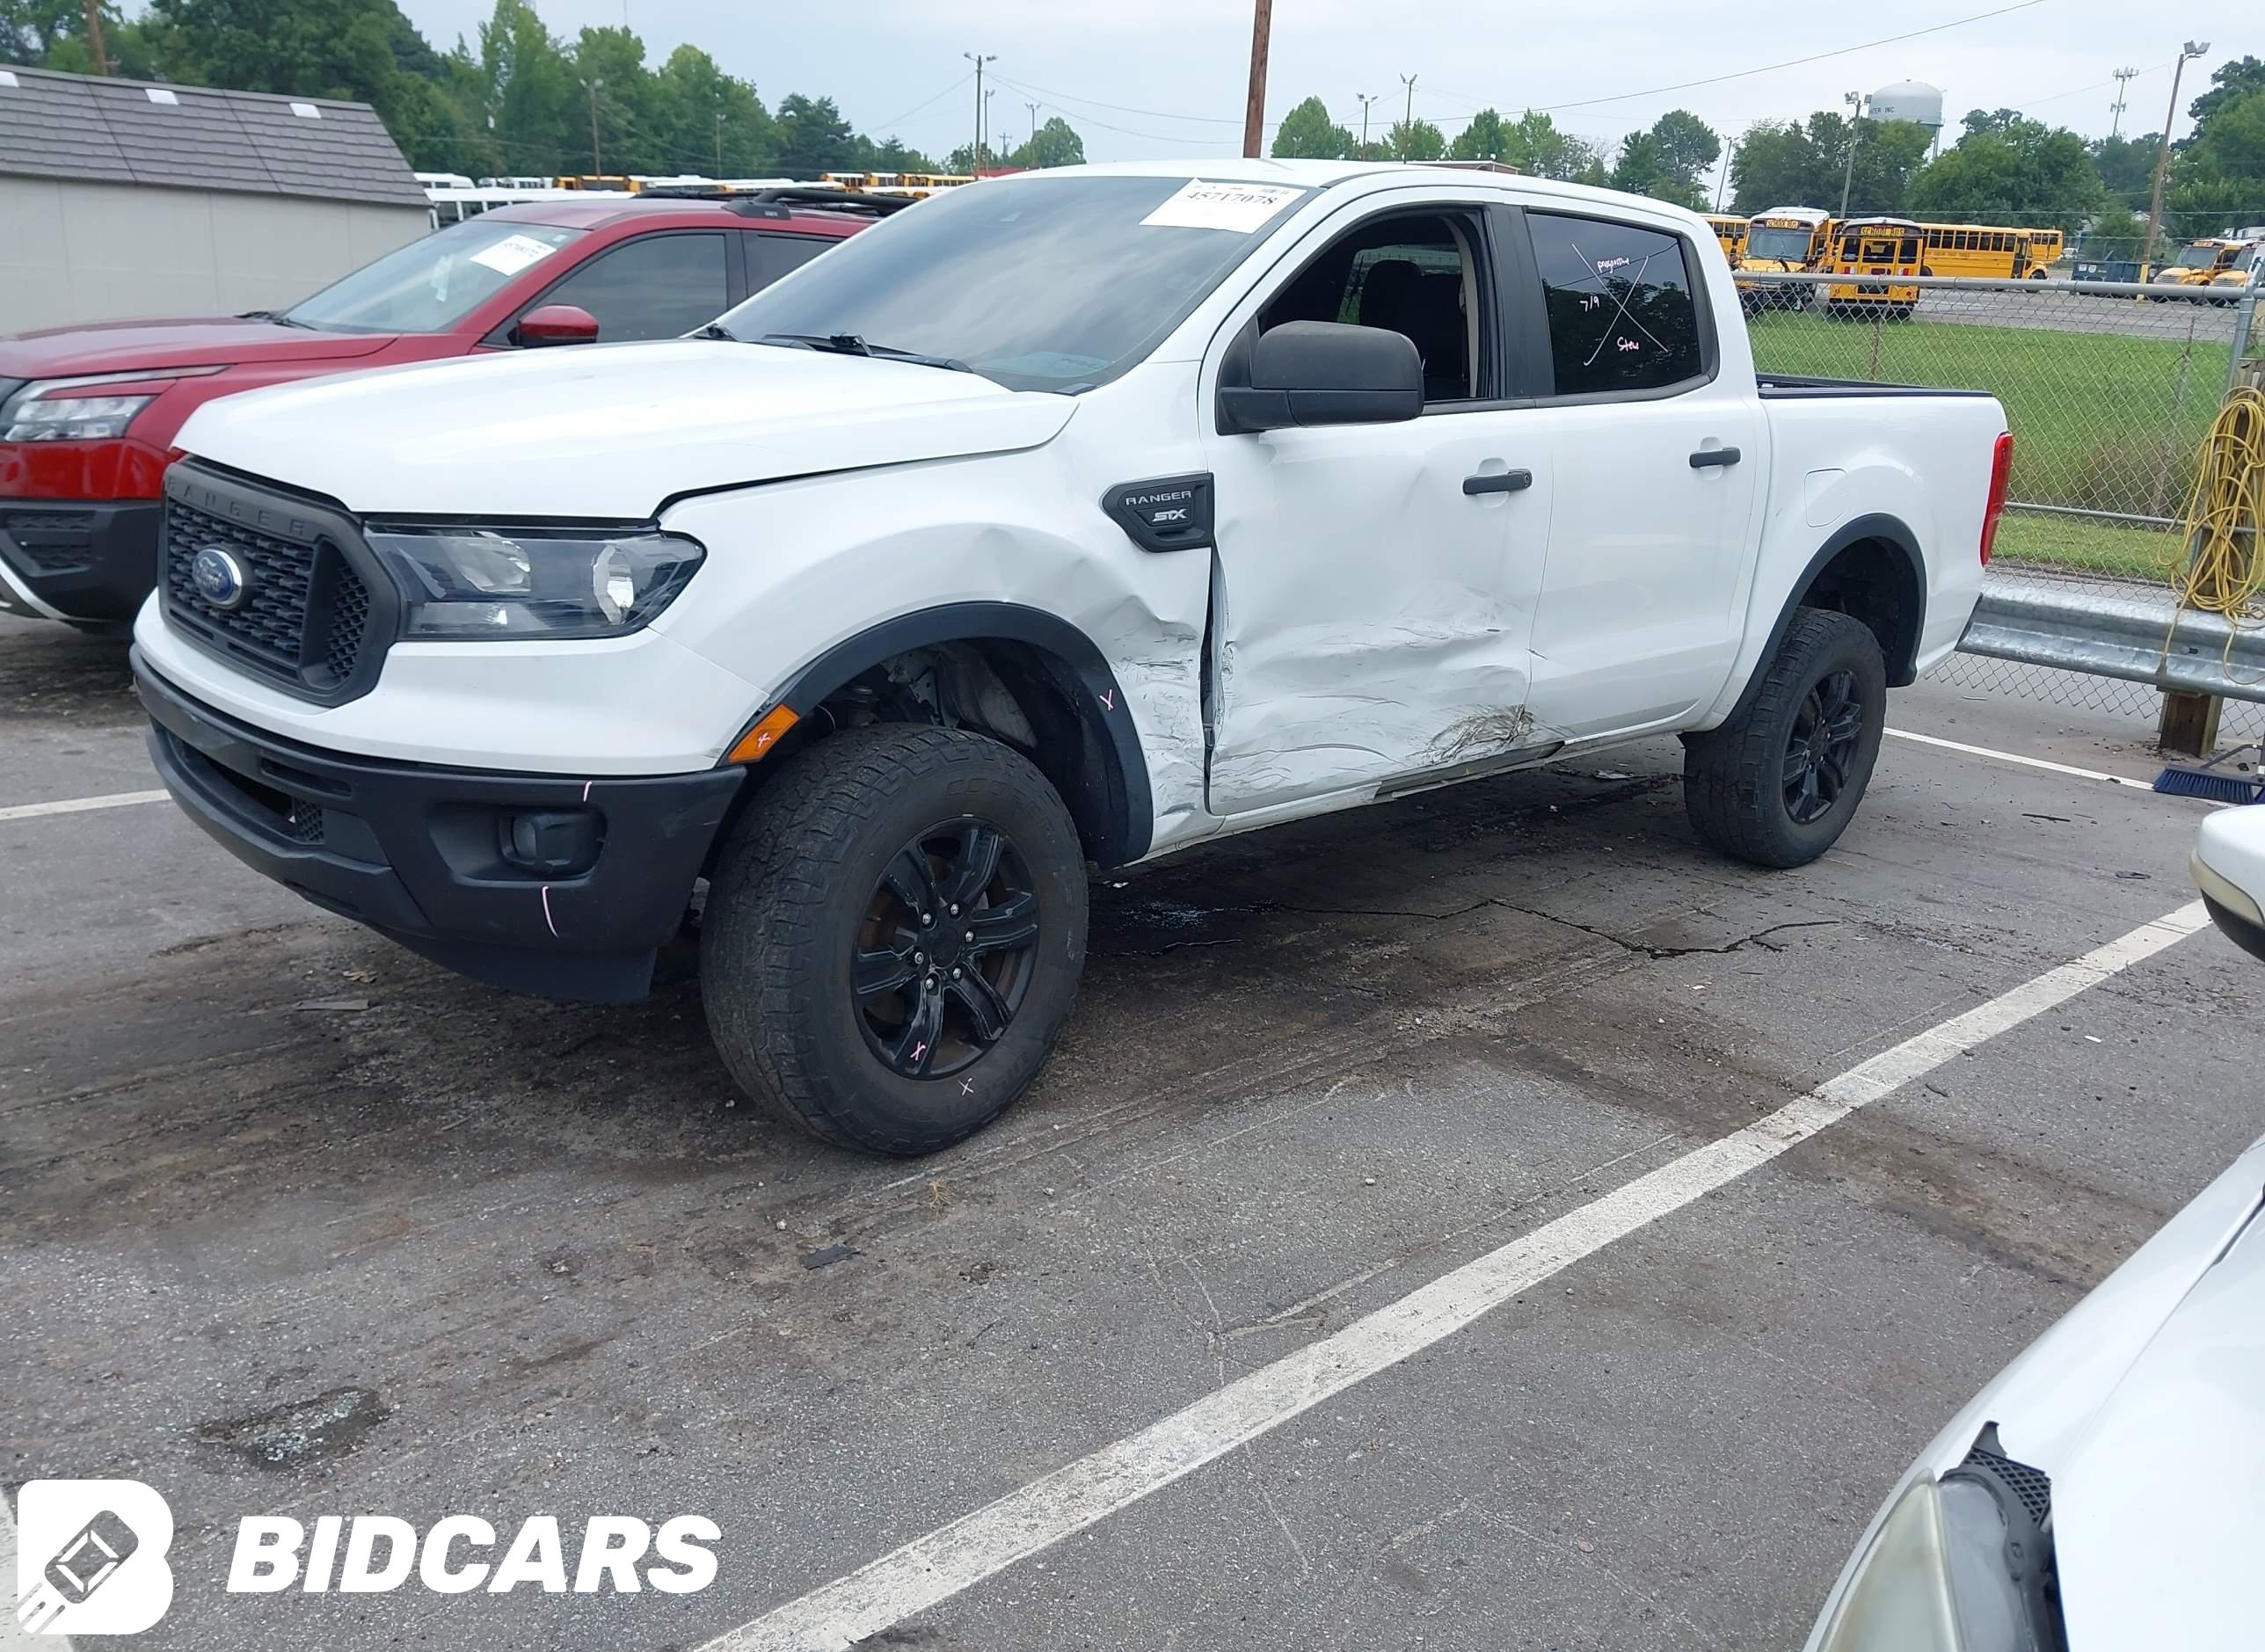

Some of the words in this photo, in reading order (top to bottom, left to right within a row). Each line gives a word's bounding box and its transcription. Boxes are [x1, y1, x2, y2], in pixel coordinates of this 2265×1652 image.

[168, 476, 304, 536] RANGER
[1125, 491, 1191, 506] RANGER
[1153, 509, 1188, 522] STX
